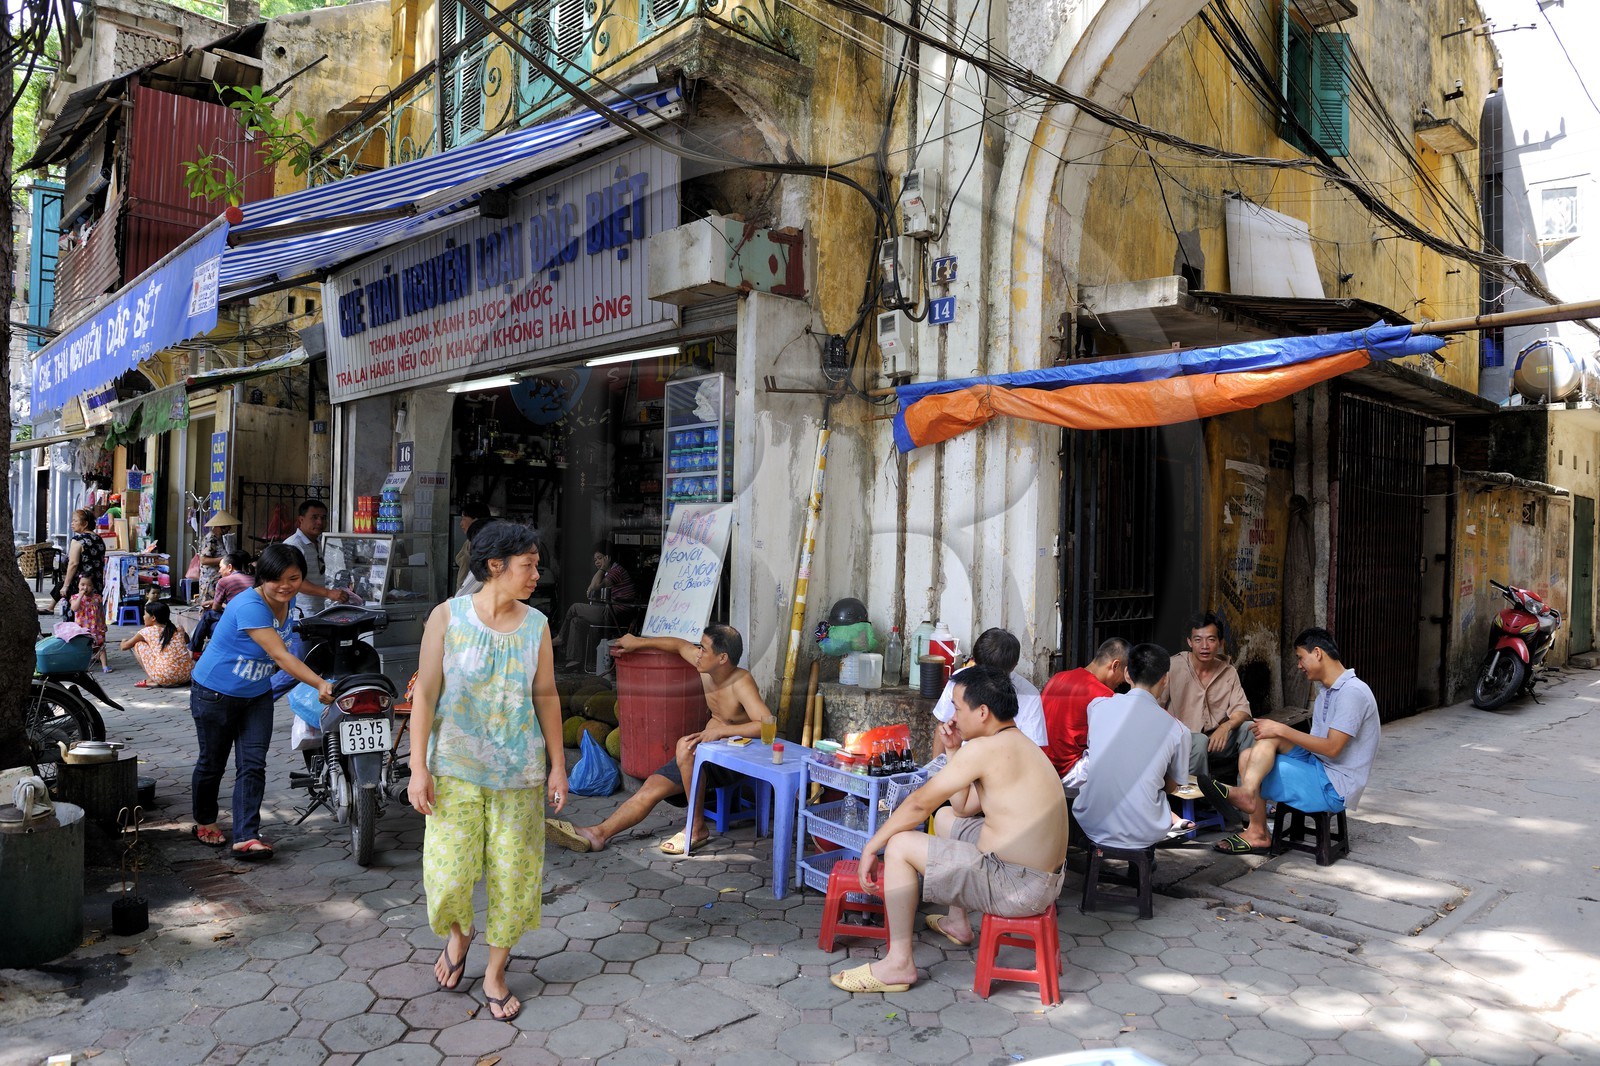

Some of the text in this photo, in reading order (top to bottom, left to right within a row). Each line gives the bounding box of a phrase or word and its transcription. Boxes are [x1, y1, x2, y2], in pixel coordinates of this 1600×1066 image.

[402, 238, 472, 317] NGUYÊN
[476, 222, 524, 294] LOẠI
[529, 192, 580, 281] ĐẶC
[586, 165, 649, 261] BIỆT
[468, 299, 507, 327] ĐƯỢC
[511, 281, 553, 315] NƯỚC
[933, 301, 950, 320] 14
[336, 363, 354, 389] TRẢ
[370, 357, 396, 380] HÀNG
[398, 348, 417, 372] NẾU
[446, 332, 489, 361] KHÁCH
[493, 318, 543, 349] KHÔNG
[550, 306, 576, 335] HÀI
[583, 295, 632, 327] LÒNG
[400, 446, 411, 462] 16
[348, 722, 383, 737] 29-Y5
[349, 736, 385, 751] 3394
